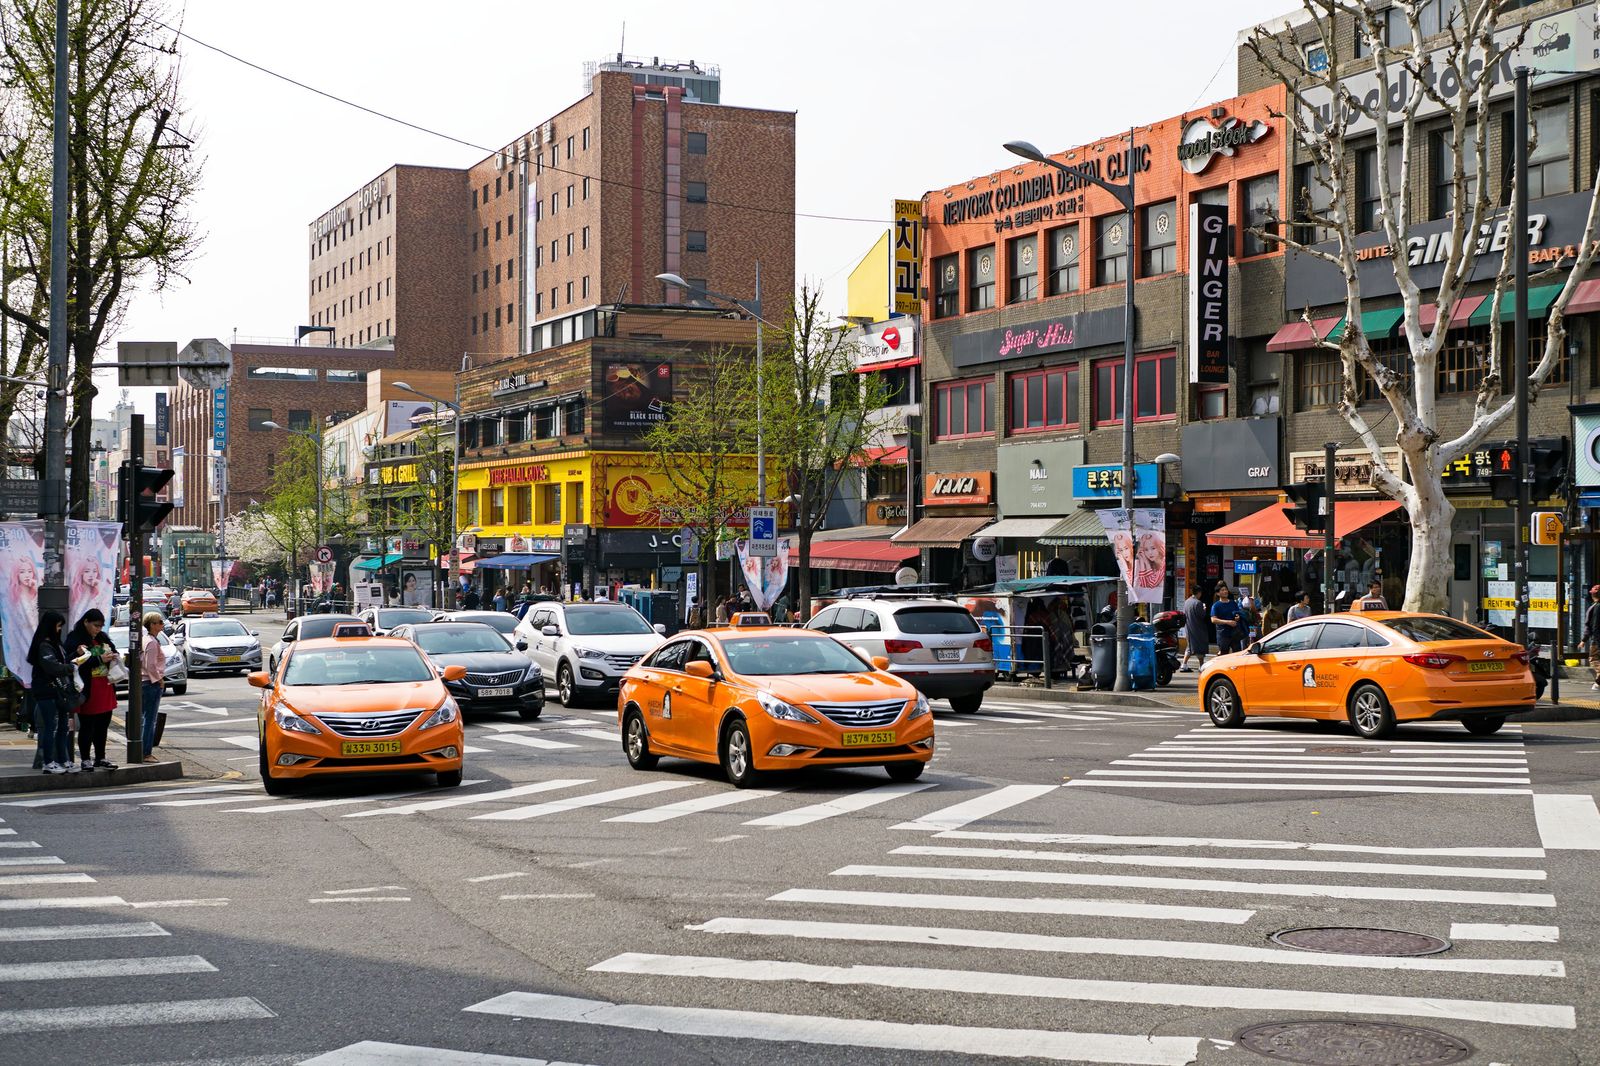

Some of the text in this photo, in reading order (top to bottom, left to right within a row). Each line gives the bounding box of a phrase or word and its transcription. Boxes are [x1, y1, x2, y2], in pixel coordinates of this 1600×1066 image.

[943, 189, 995, 226] NEWYORK
[995, 173, 1055, 212] COLUMBIA
[896, 202, 921, 214] DENTAL
[994, 215, 1014, 233] 뉴욕
[1014, 203, 1053, 229] 컬럼비아
[1055, 198, 1076, 216] 치과
[897, 217, 921, 300] 치과
[1529, 248, 1561, 264] BAR
[1203, 215, 1224, 342] GINGER
[1000, 323, 1073, 355] Sugar Hill
[1206, 350, 1221, 359] BAR
[659, 367, 668, 376] 3F
[1200, 365, 1226, 374] LOUNGE
[1029, 468, 1048, 480] NAIL
[1248, 466, 1271, 478] GRAY
[1242, 563, 1255, 572] ATM
[1363, 602, 1384, 611] TAXI
[1316, 674, 1340, 682] HAECHI
[871, 733, 892, 743] 2531
[373, 742, 398, 752] 3015
